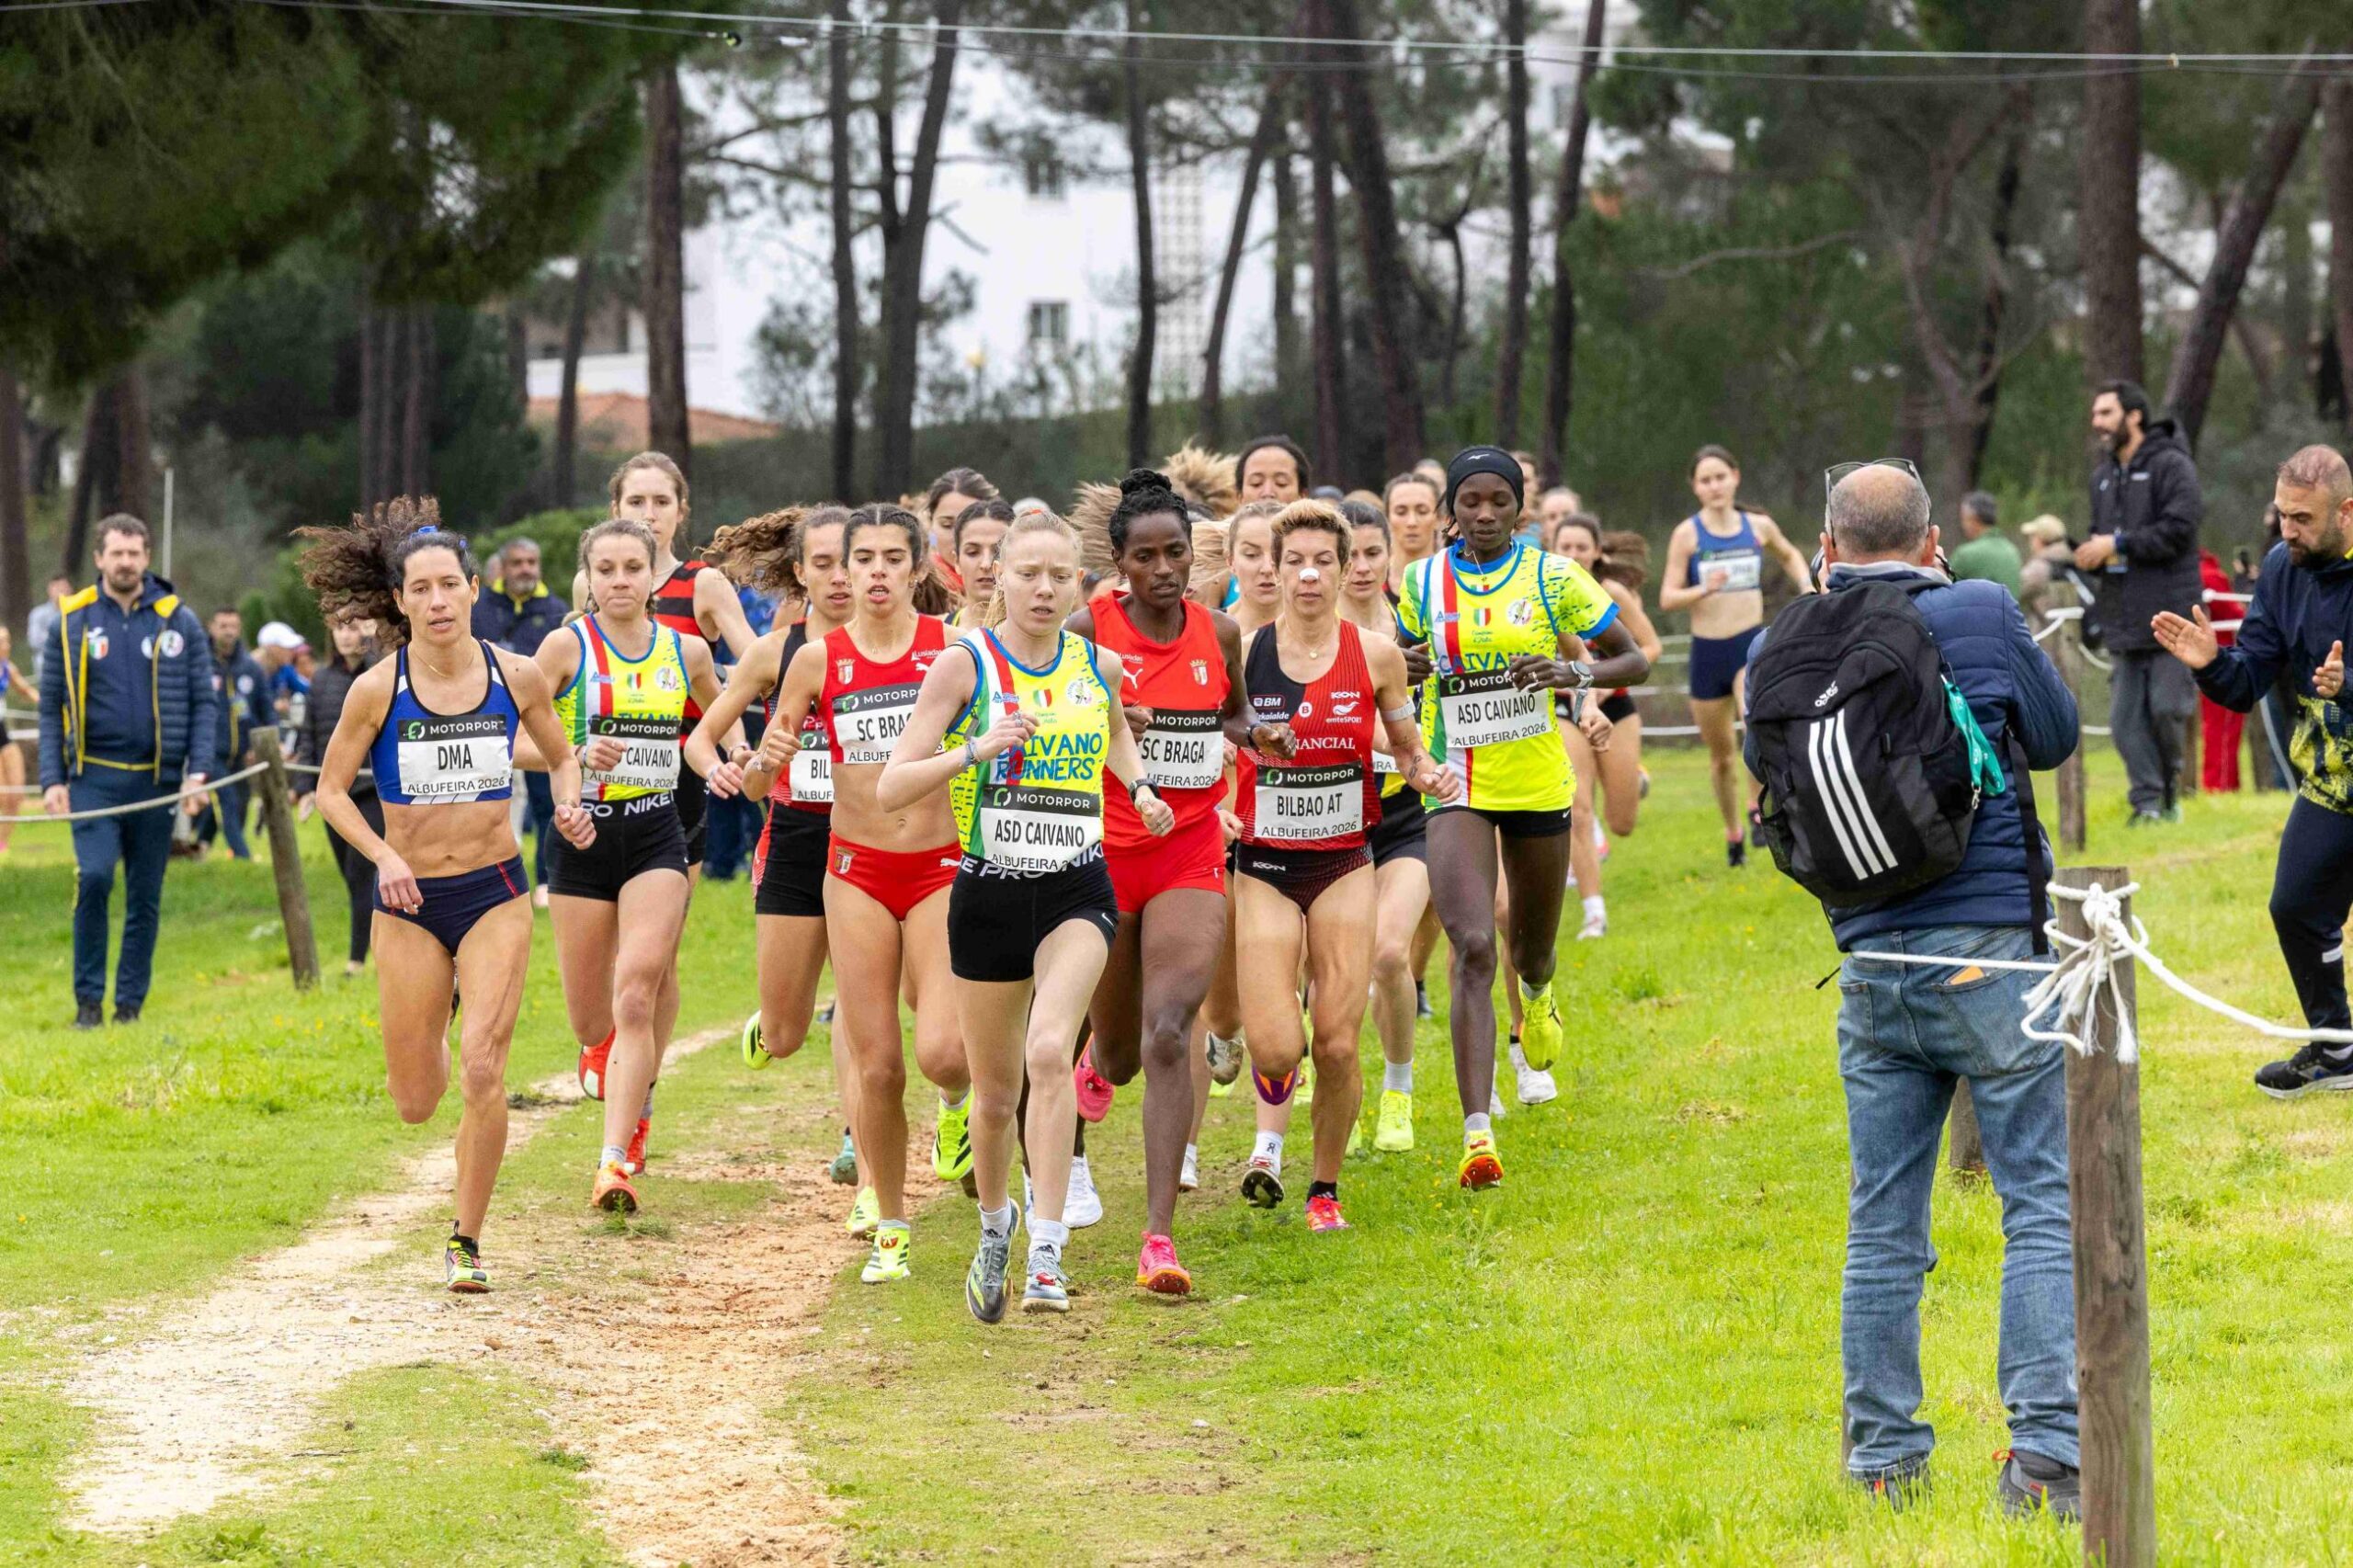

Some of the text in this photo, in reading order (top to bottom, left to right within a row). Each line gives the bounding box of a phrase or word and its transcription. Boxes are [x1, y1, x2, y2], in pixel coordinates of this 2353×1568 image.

[1438, 651, 1530, 673] CAIVA
[1264, 697, 1281, 707] BM
[1458, 693, 1536, 725] ASD CAIVANO
[430, 721, 498, 735] MOTORPOR
[620, 723, 677, 734] MOTORPOR
[857, 718, 876, 741] SC
[1156, 715, 1217, 727] MOTORPOR
[1453, 722, 1547, 746] ALBUFEIRA 2026
[438, 744, 473, 770] DMA
[626, 746, 673, 768] CAIVANO
[1142, 737, 1205, 764] SC BRAGA
[811, 758, 832, 779] BIL
[995, 757, 1096, 781] RUNNERS
[1287, 768, 1354, 783] MOTORPOR
[407, 777, 505, 794] ALBUFEIRA 2026
[589, 771, 652, 788] ALBUFEIRA
[1194, 775, 1217, 787] 2026
[624, 793, 671, 816] NIKE
[798, 790, 835, 801] ALBUF
[1017, 792, 1090, 809] MOTORPOR
[1277, 792, 1343, 817] BILBAO AT
[995, 819, 1085, 848] ASD CAIVANO
[1261, 821, 1357, 838] ALBUFEIRA 2026
[992, 853, 1058, 869] ALBUFEIRA
